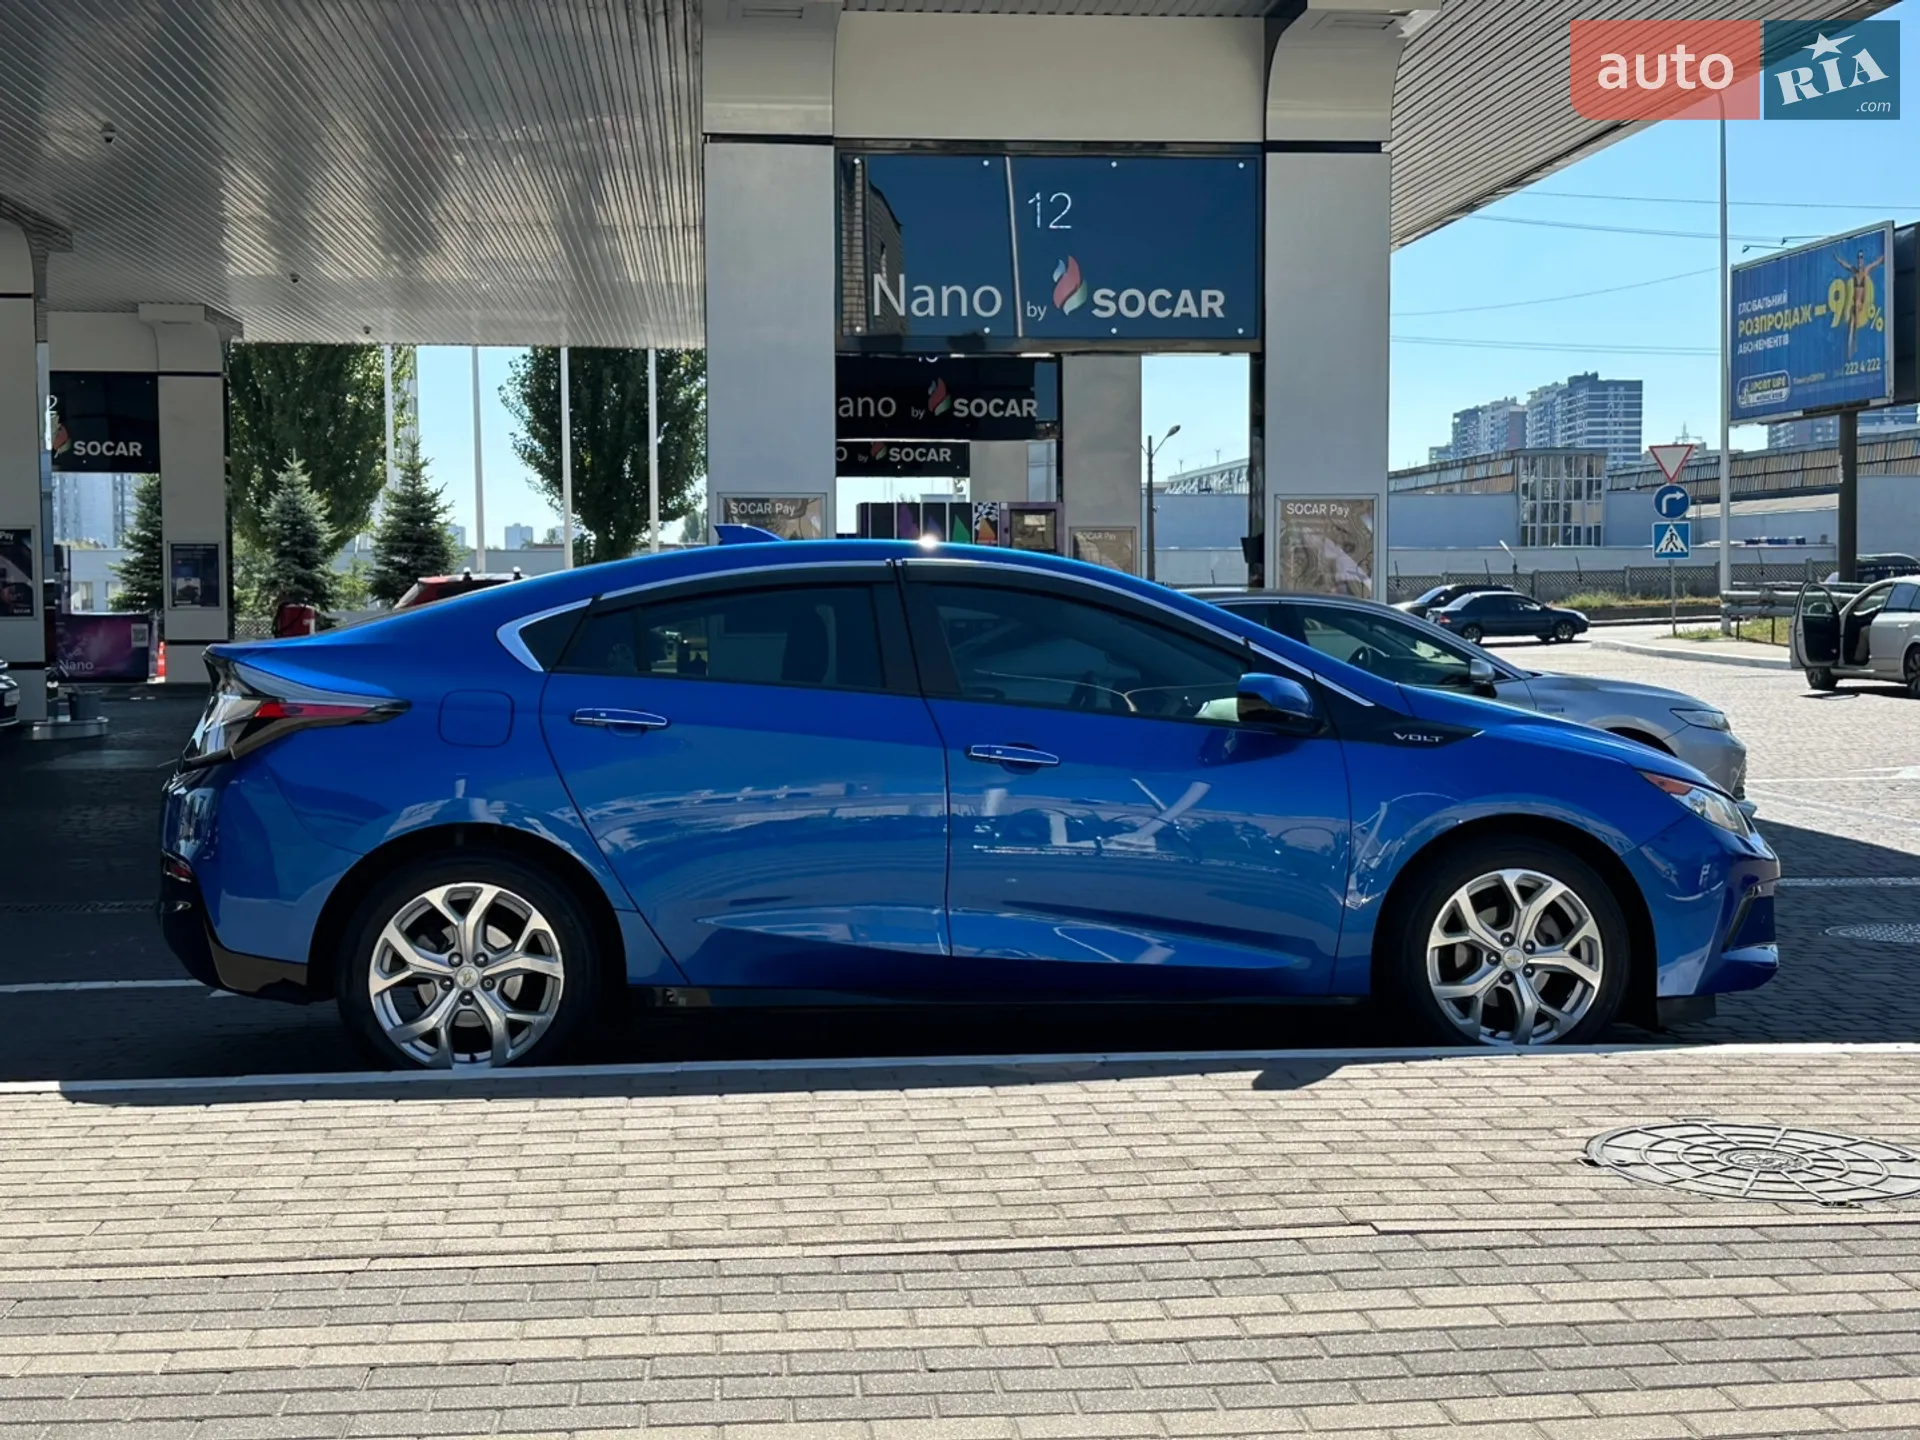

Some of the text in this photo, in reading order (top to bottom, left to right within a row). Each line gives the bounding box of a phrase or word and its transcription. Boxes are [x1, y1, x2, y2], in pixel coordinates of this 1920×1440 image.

[1028, 192, 1072, 229] 12
[872, 272, 1225, 321] Nano by SOCAR
[1738, 290, 1788, 315] ГЛОБАЛЬНИЙ
[1738, 304, 1812, 338] РОЗПРОДАЖ
[838, 396, 1038, 420] ano by SOCAR
[73, 441, 142, 457] SOCAR
[889, 447, 951, 462] SOCAR
[730, 502, 796, 516] SOCAR Pay
[1286, 503, 1350, 518] SOCAR Pay
[1393, 732, 1444, 743] VOLT
